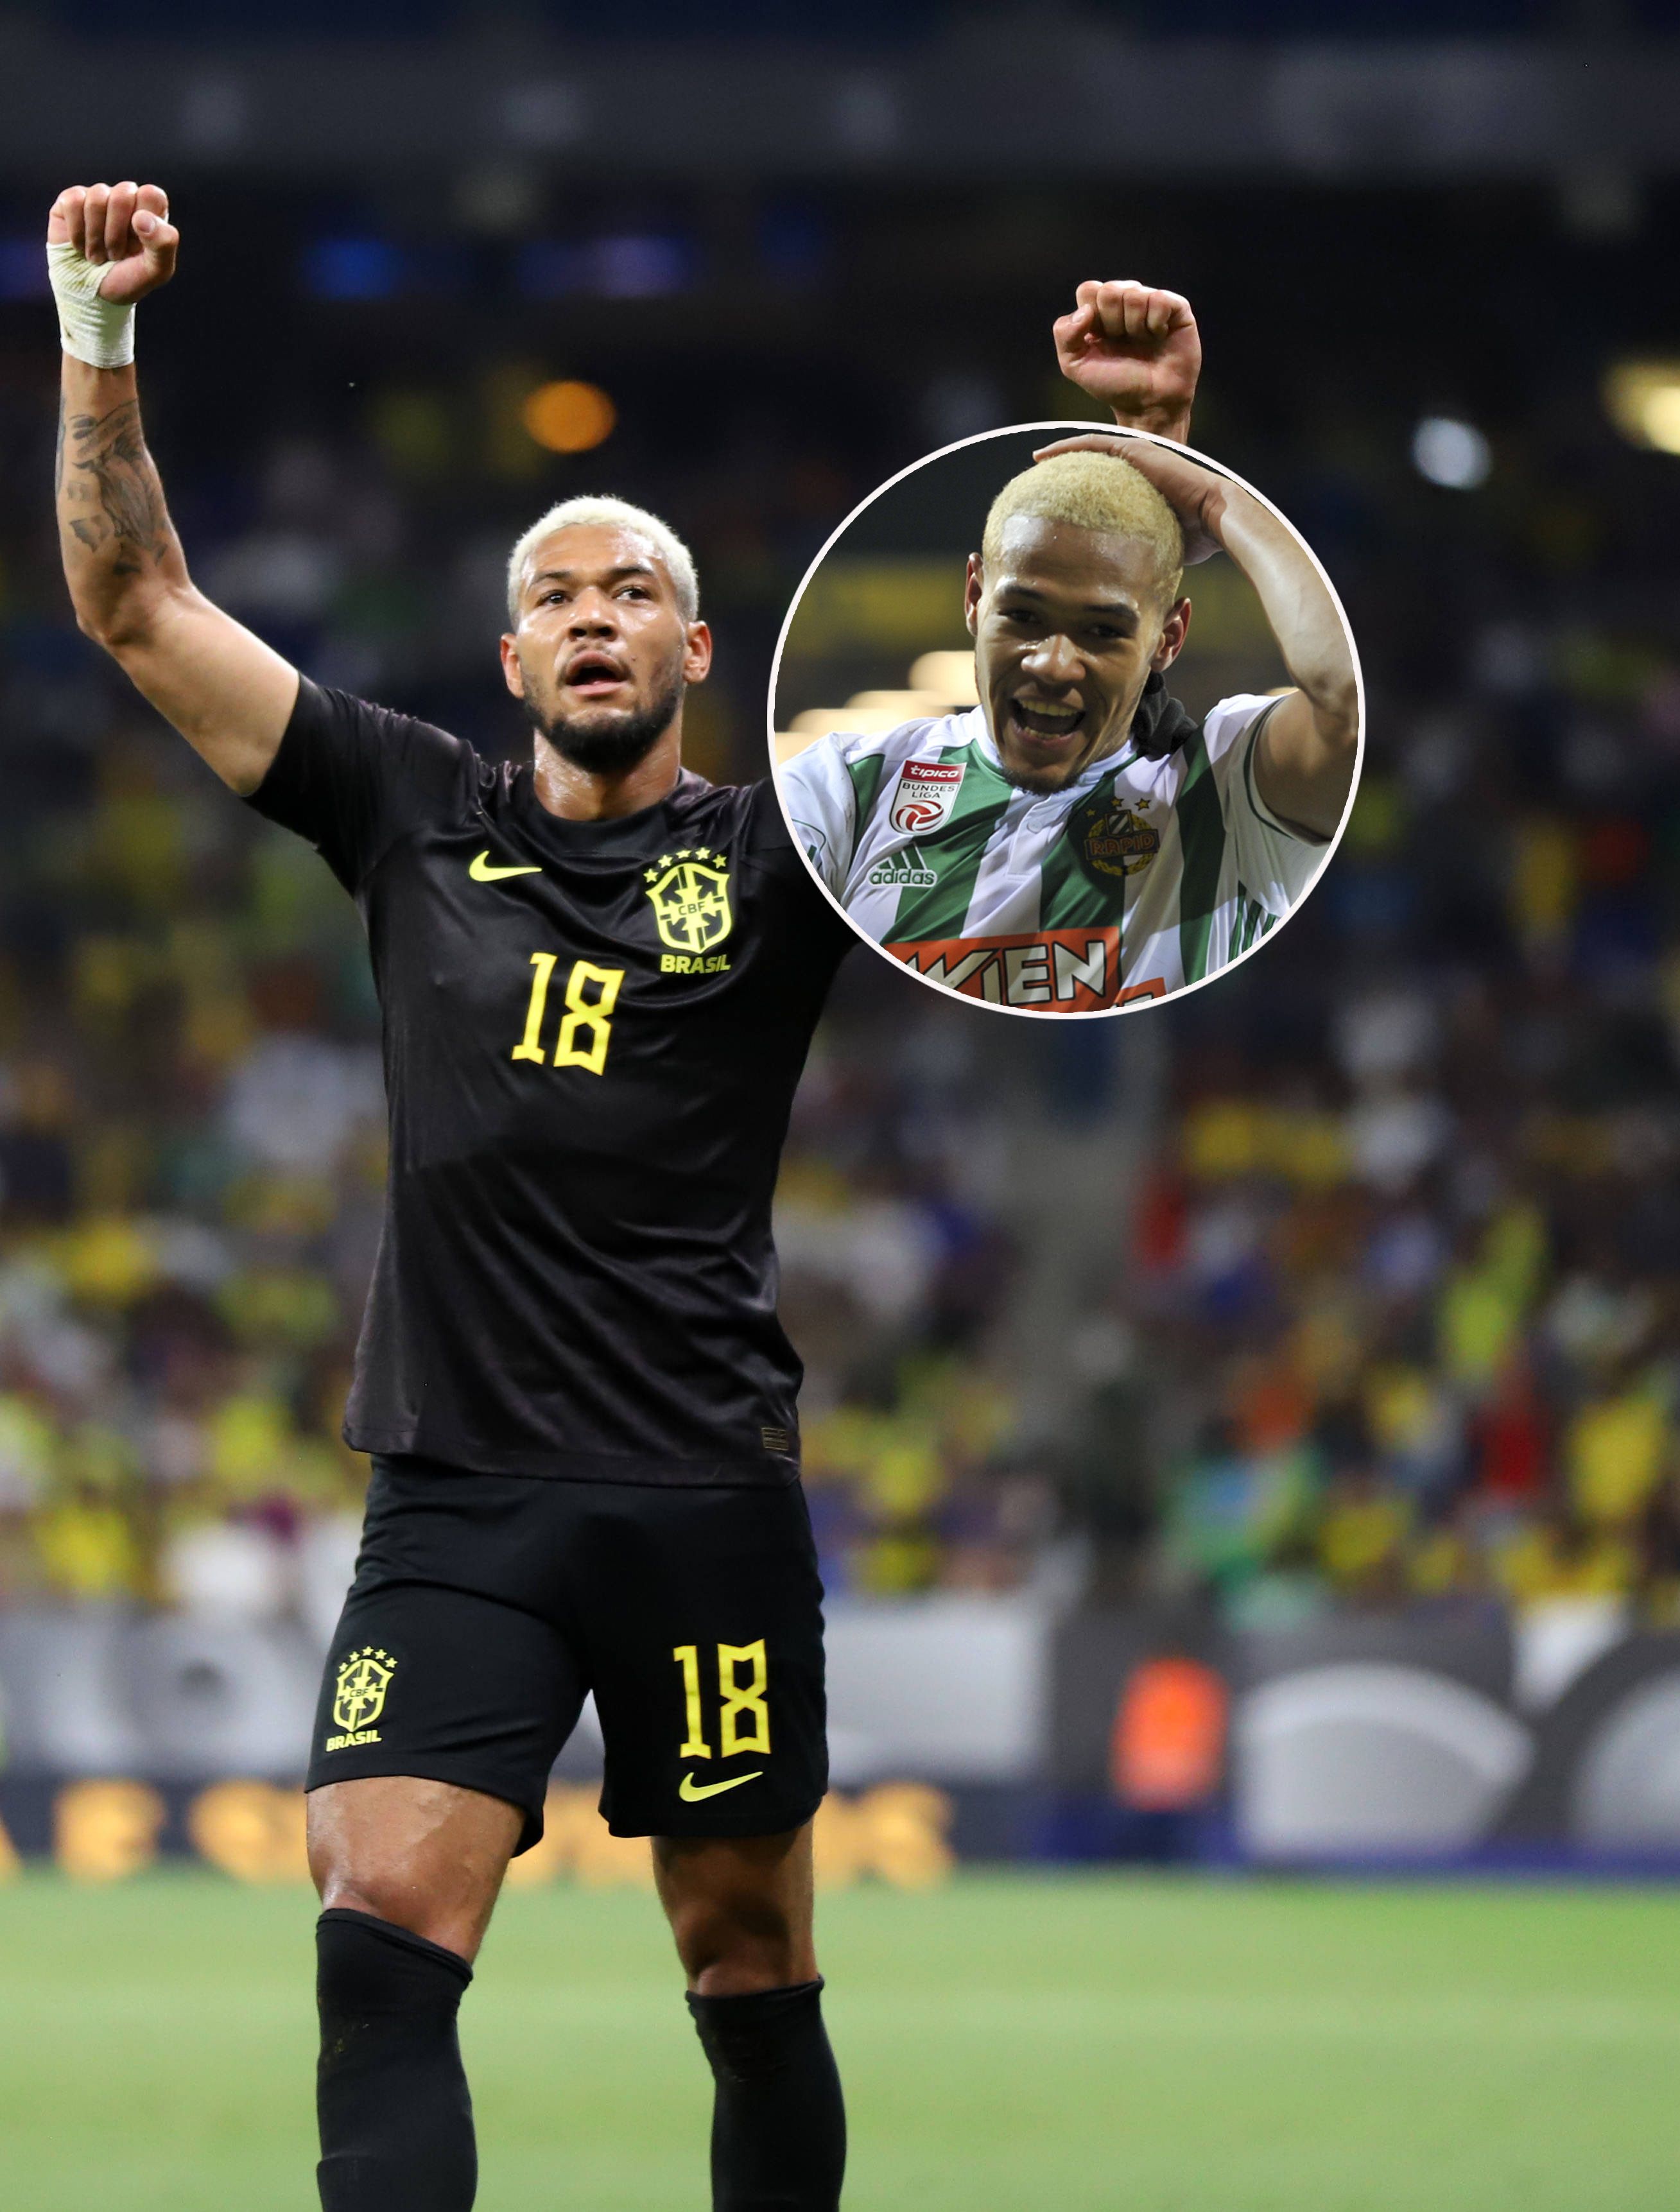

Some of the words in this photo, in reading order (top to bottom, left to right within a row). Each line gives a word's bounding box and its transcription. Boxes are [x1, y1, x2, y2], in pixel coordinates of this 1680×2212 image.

[910, 765, 959, 778] tipico
[903, 782, 955, 791] BUNDES
[1089, 834, 1154, 855] RAPID
[870, 868, 935, 885] adidas
[678, 901, 706, 916] CBF
[660, 954, 731, 975] BRASIL
[512, 952, 625, 1076] 18
[350, 1688, 369, 1698] CBF
[673, 1638, 771, 1759] 18
[326, 1729, 382, 1752] BRASIL
